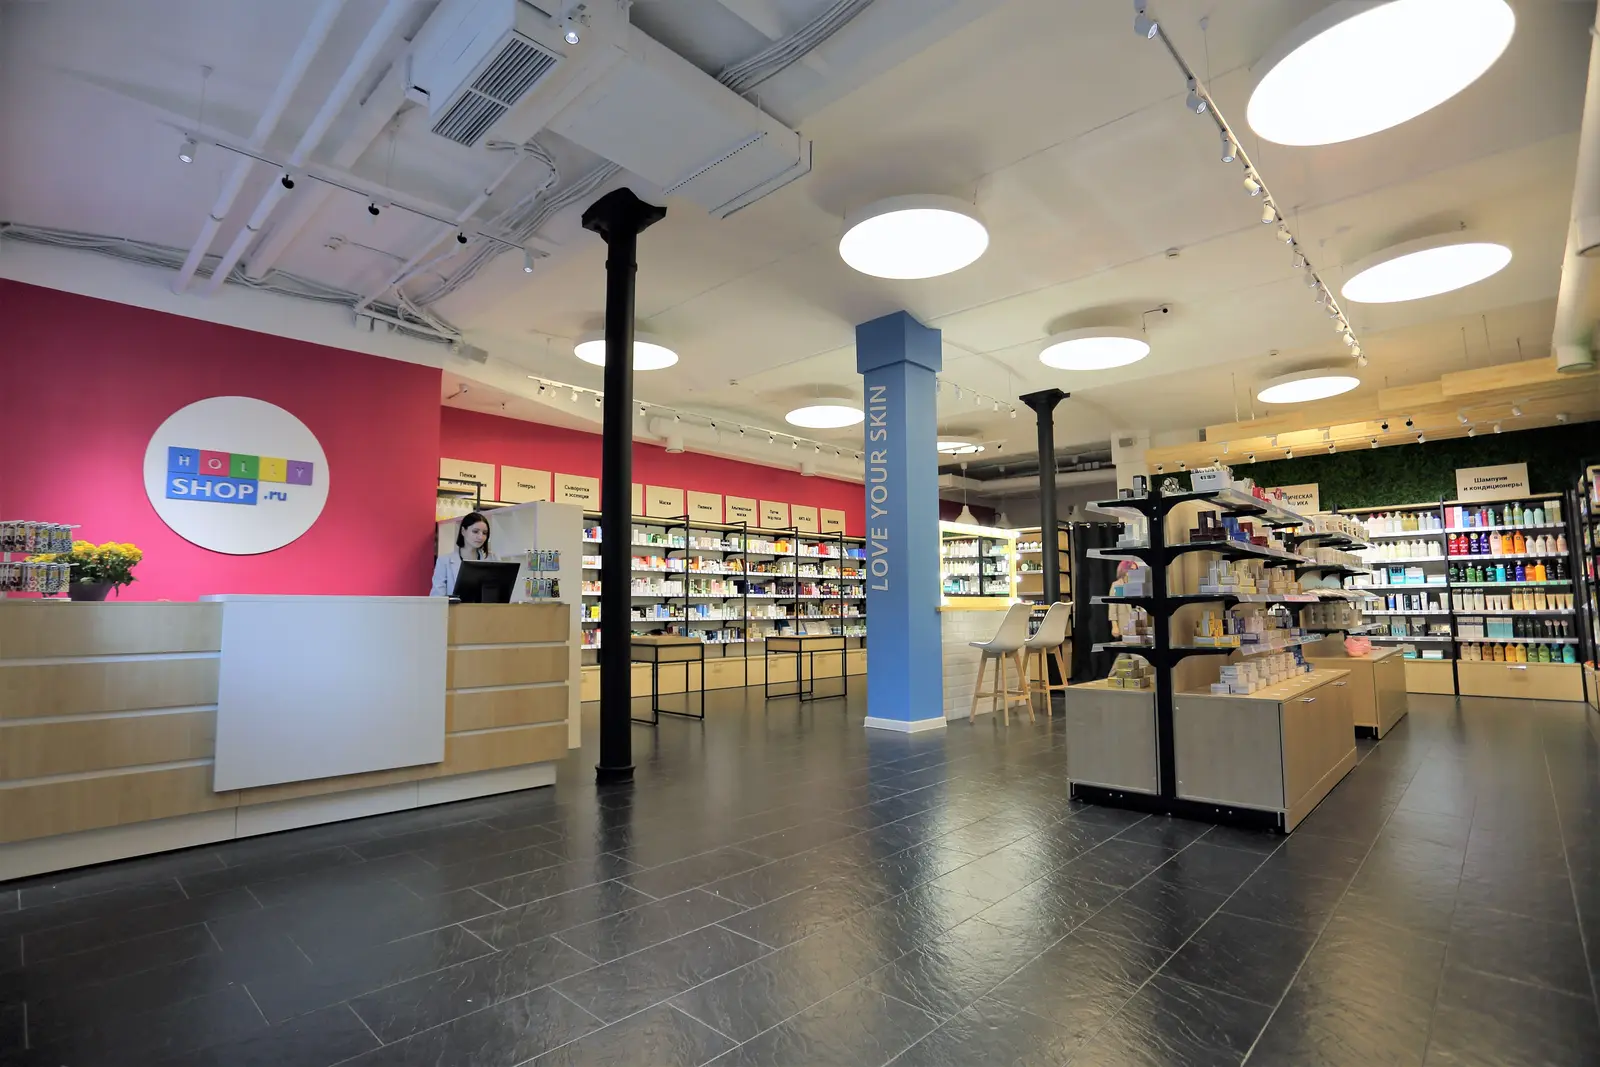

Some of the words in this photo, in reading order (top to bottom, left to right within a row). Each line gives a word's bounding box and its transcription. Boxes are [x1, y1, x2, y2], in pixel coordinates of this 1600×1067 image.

[869, 385, 887, 441] SKIN
[178, 453, 305, 478] HOLLY
[171, 477, 254, 500] SHOP
[263, 490, 287, 501] .ru
[517, 481, 536, 489] Тонеры
[564, 484, 590, 492] Сыворотки
[870, 449, 888, 519] YOUR
[1469, 481, 1523, 491] кондиционеры
[1473, 475, 1508, 483] Шампуни
[871, 527, 889, 591] LOVE
